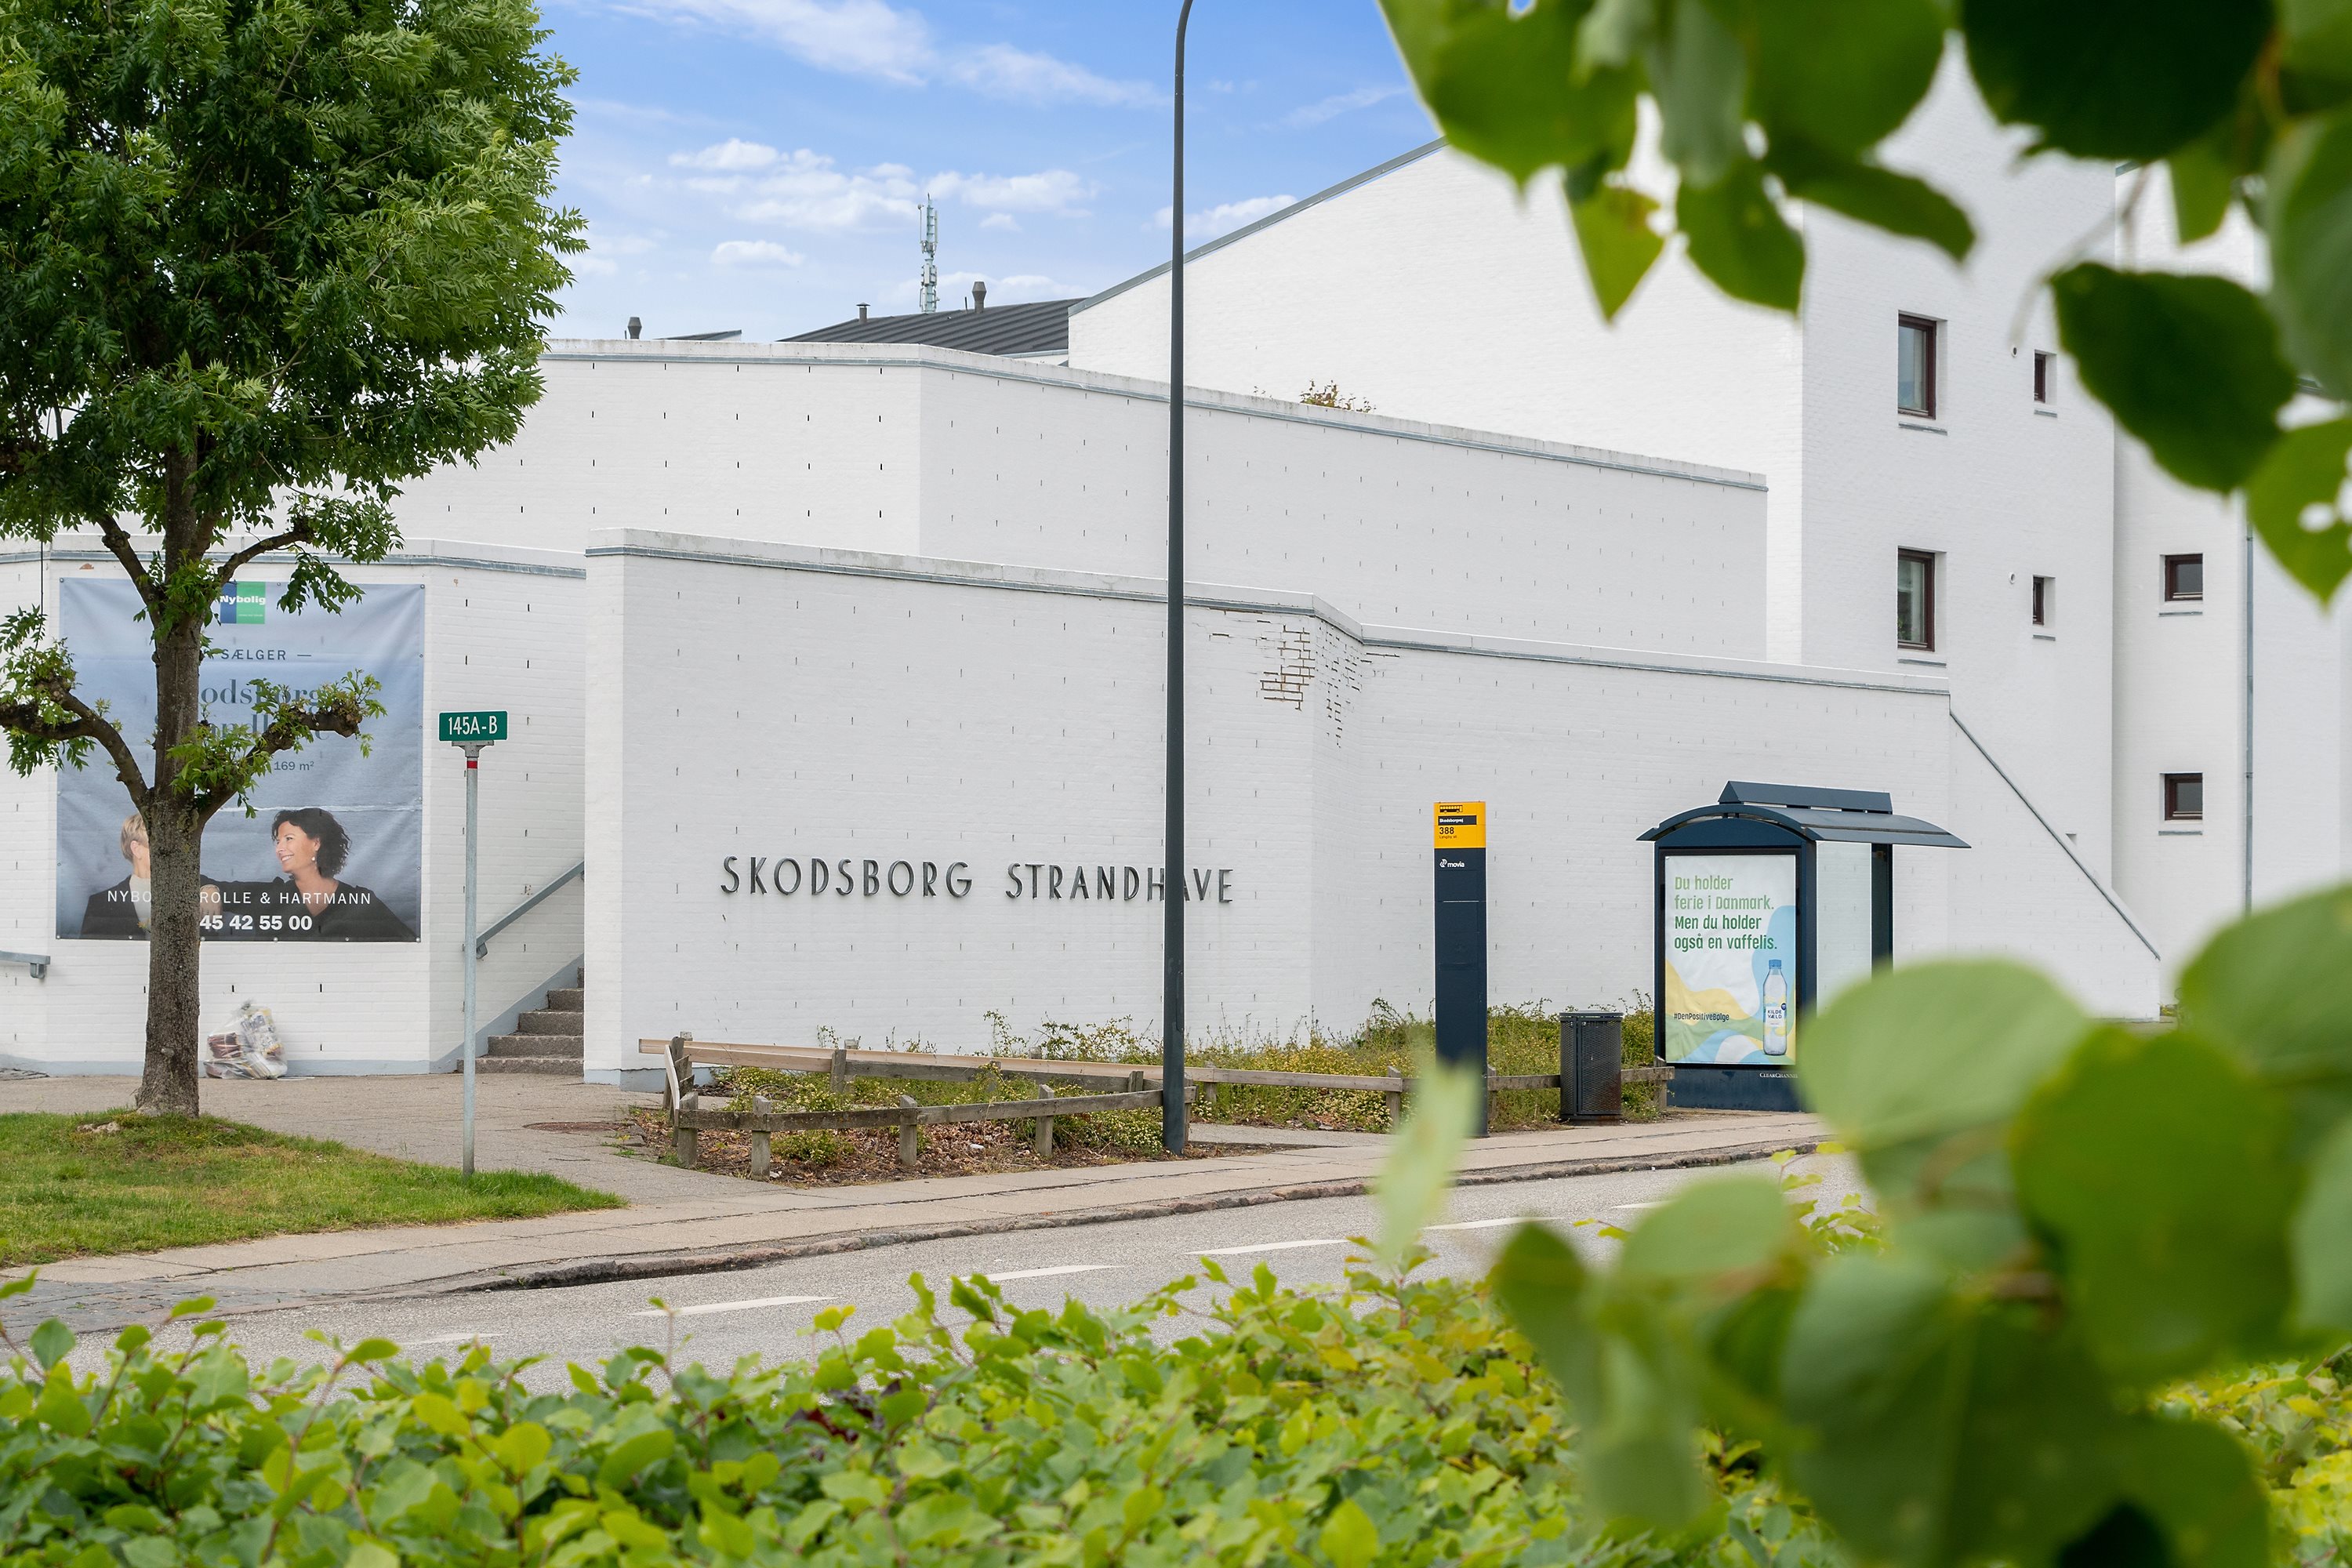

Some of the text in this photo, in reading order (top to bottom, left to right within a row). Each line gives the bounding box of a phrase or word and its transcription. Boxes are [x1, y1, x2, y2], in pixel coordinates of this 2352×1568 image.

[220, 595, 267, 605] Nybolig
[221, 649, 287, 660] SÆLGER
[448, 715, 498, 735] 145A-B
[274, 761, 296, 771] 169
[720, 855, 973, 898] SKODSBORG
[1675, 875, 1733, 890] Du holder
[107, 891, 371, 905] NYBO ROLLE & HARTMANN
[1675, 895, 1774, 909] ferie i Danmark.
[200, 915, 313, 931] 45 42 55 00
[1675, 915, 1762, 929] Men du holder
[1674, 933, 1777, 953] også en vaffelis.
